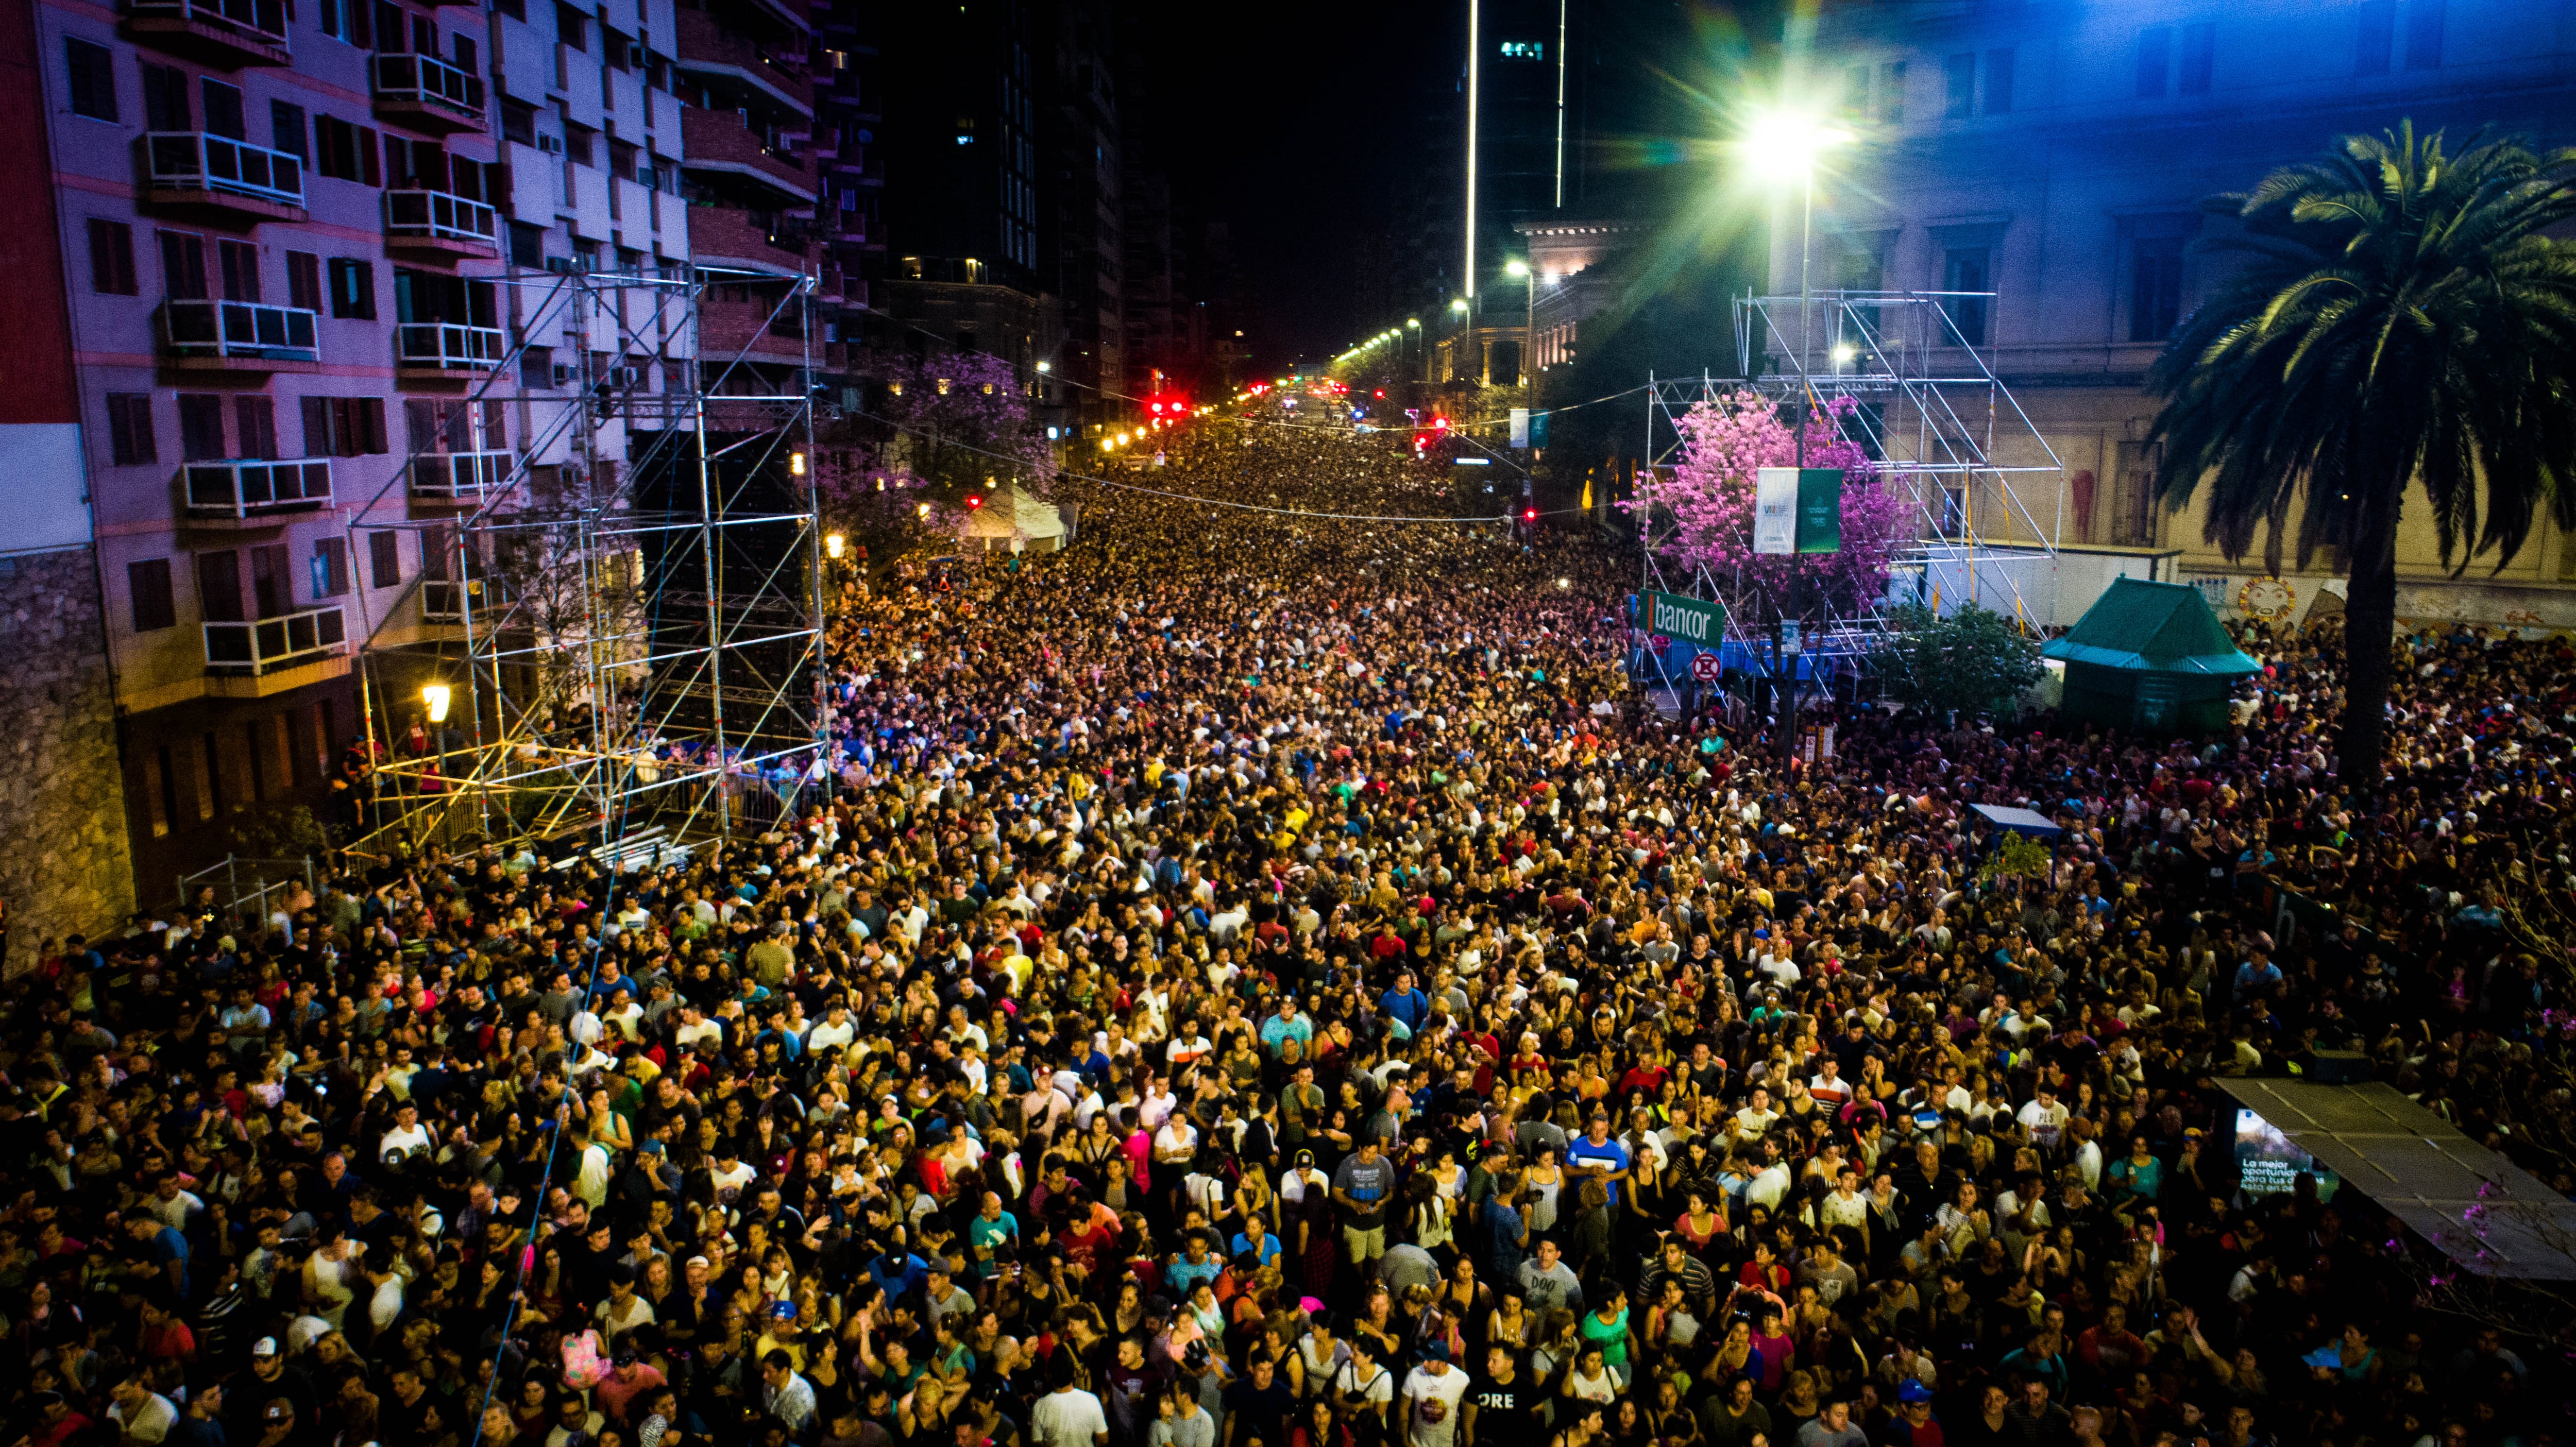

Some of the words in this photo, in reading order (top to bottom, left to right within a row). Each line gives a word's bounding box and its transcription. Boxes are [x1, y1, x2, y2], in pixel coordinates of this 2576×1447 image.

[1655, 595, 1710, 640] bancor
[2243, 1158, 2257, 1168] La
[2259, 1160, 2289, 1170] mejor
[2268, 1176, 2285, 1184] tus
